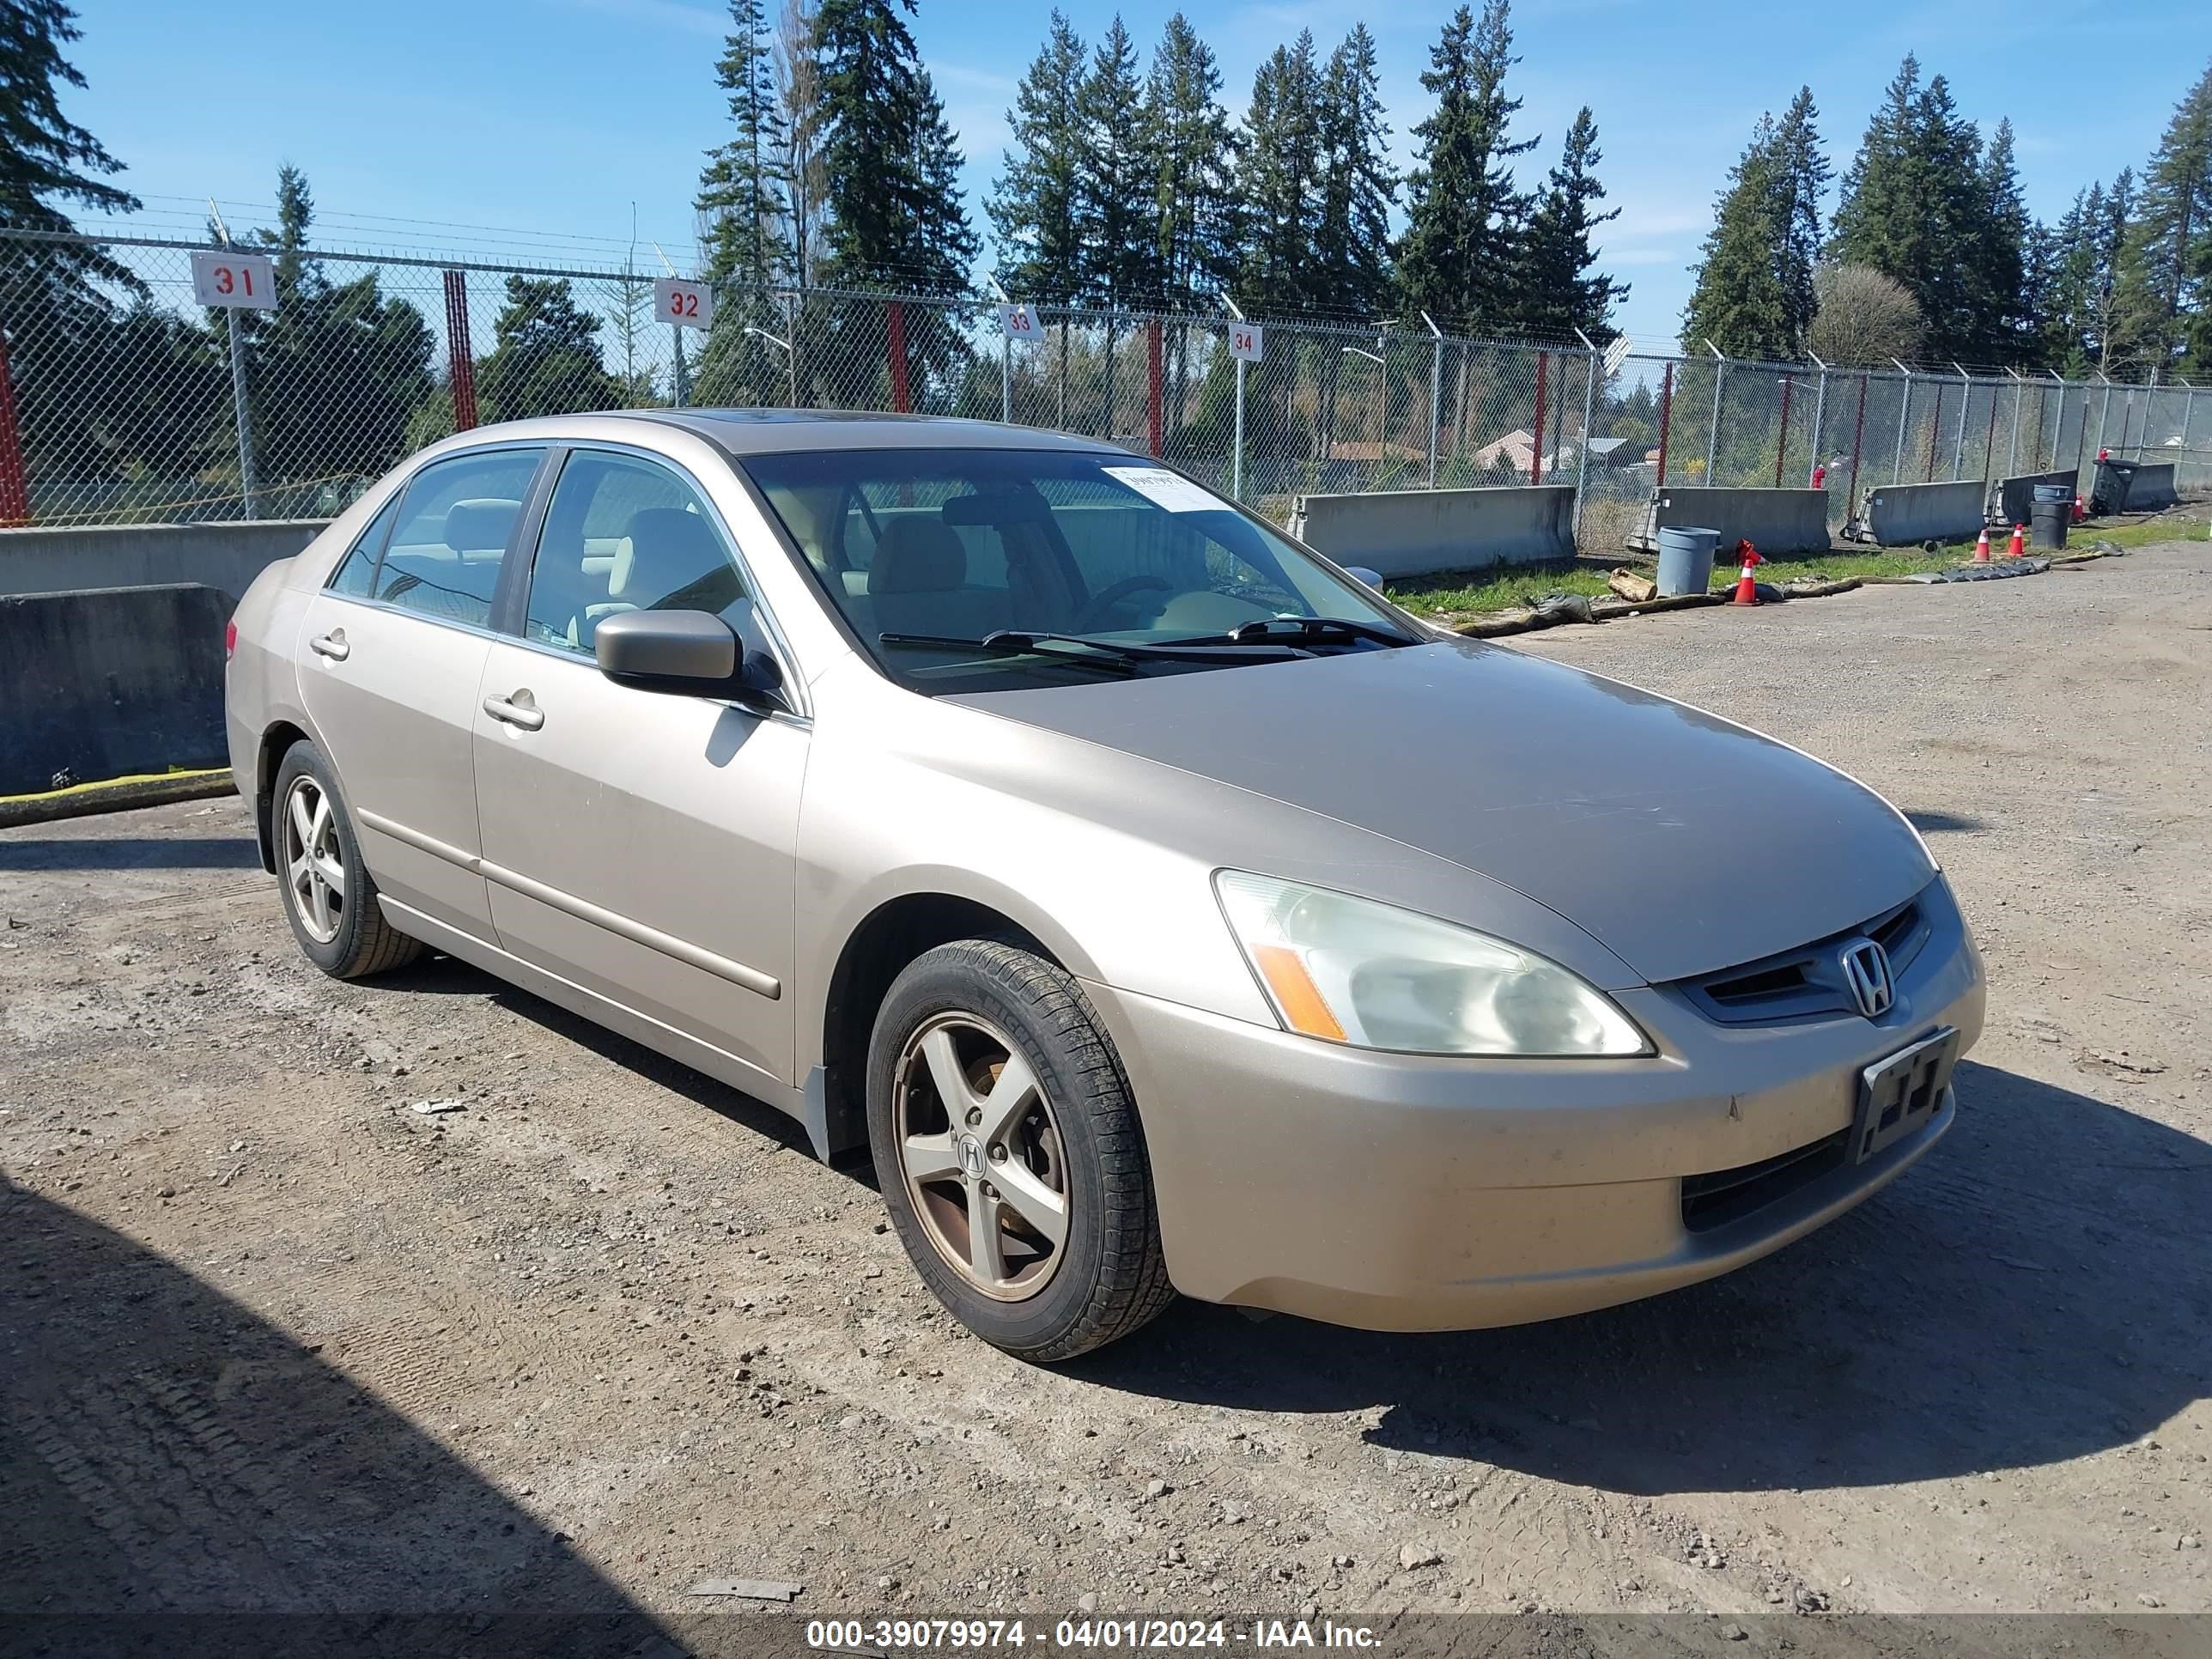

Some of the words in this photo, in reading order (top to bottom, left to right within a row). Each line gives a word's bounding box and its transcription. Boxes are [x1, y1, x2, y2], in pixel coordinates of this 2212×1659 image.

[214, 267, 252, 296] 31
[672, 292, 698, 317] 32
[1009, 313, 1030, 331] 33
[1236, 332, 1252, 352] 34
